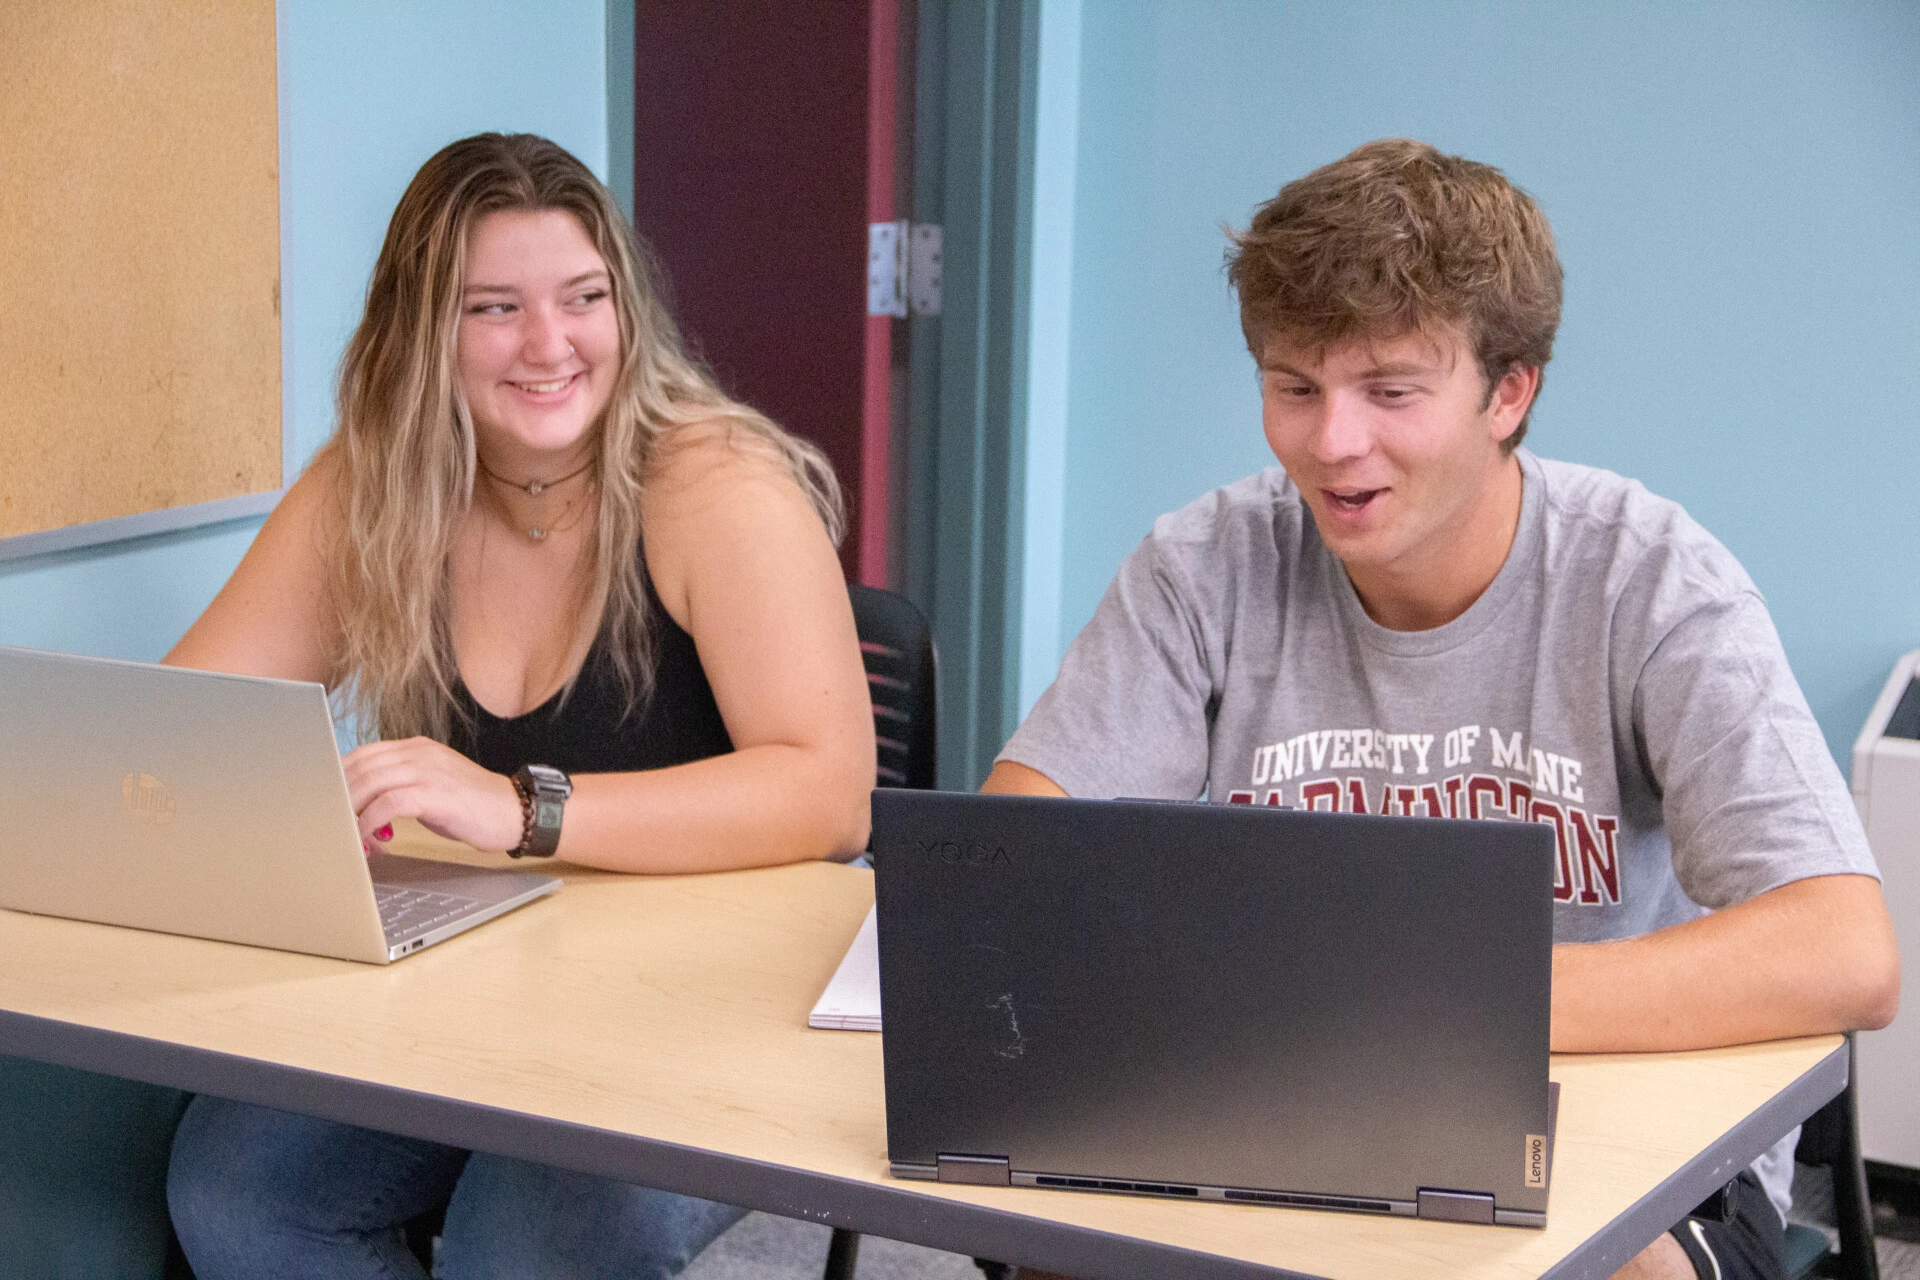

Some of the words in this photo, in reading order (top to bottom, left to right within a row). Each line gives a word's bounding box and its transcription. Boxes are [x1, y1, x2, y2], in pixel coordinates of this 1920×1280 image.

[1251, 728, 1434, 786] UNIVERSTY
[1443, 725, 1481, 769] OF
[916, 840, 1012, 866] YOGA
[1529, 1139, 1542, 1184] Lenovo
